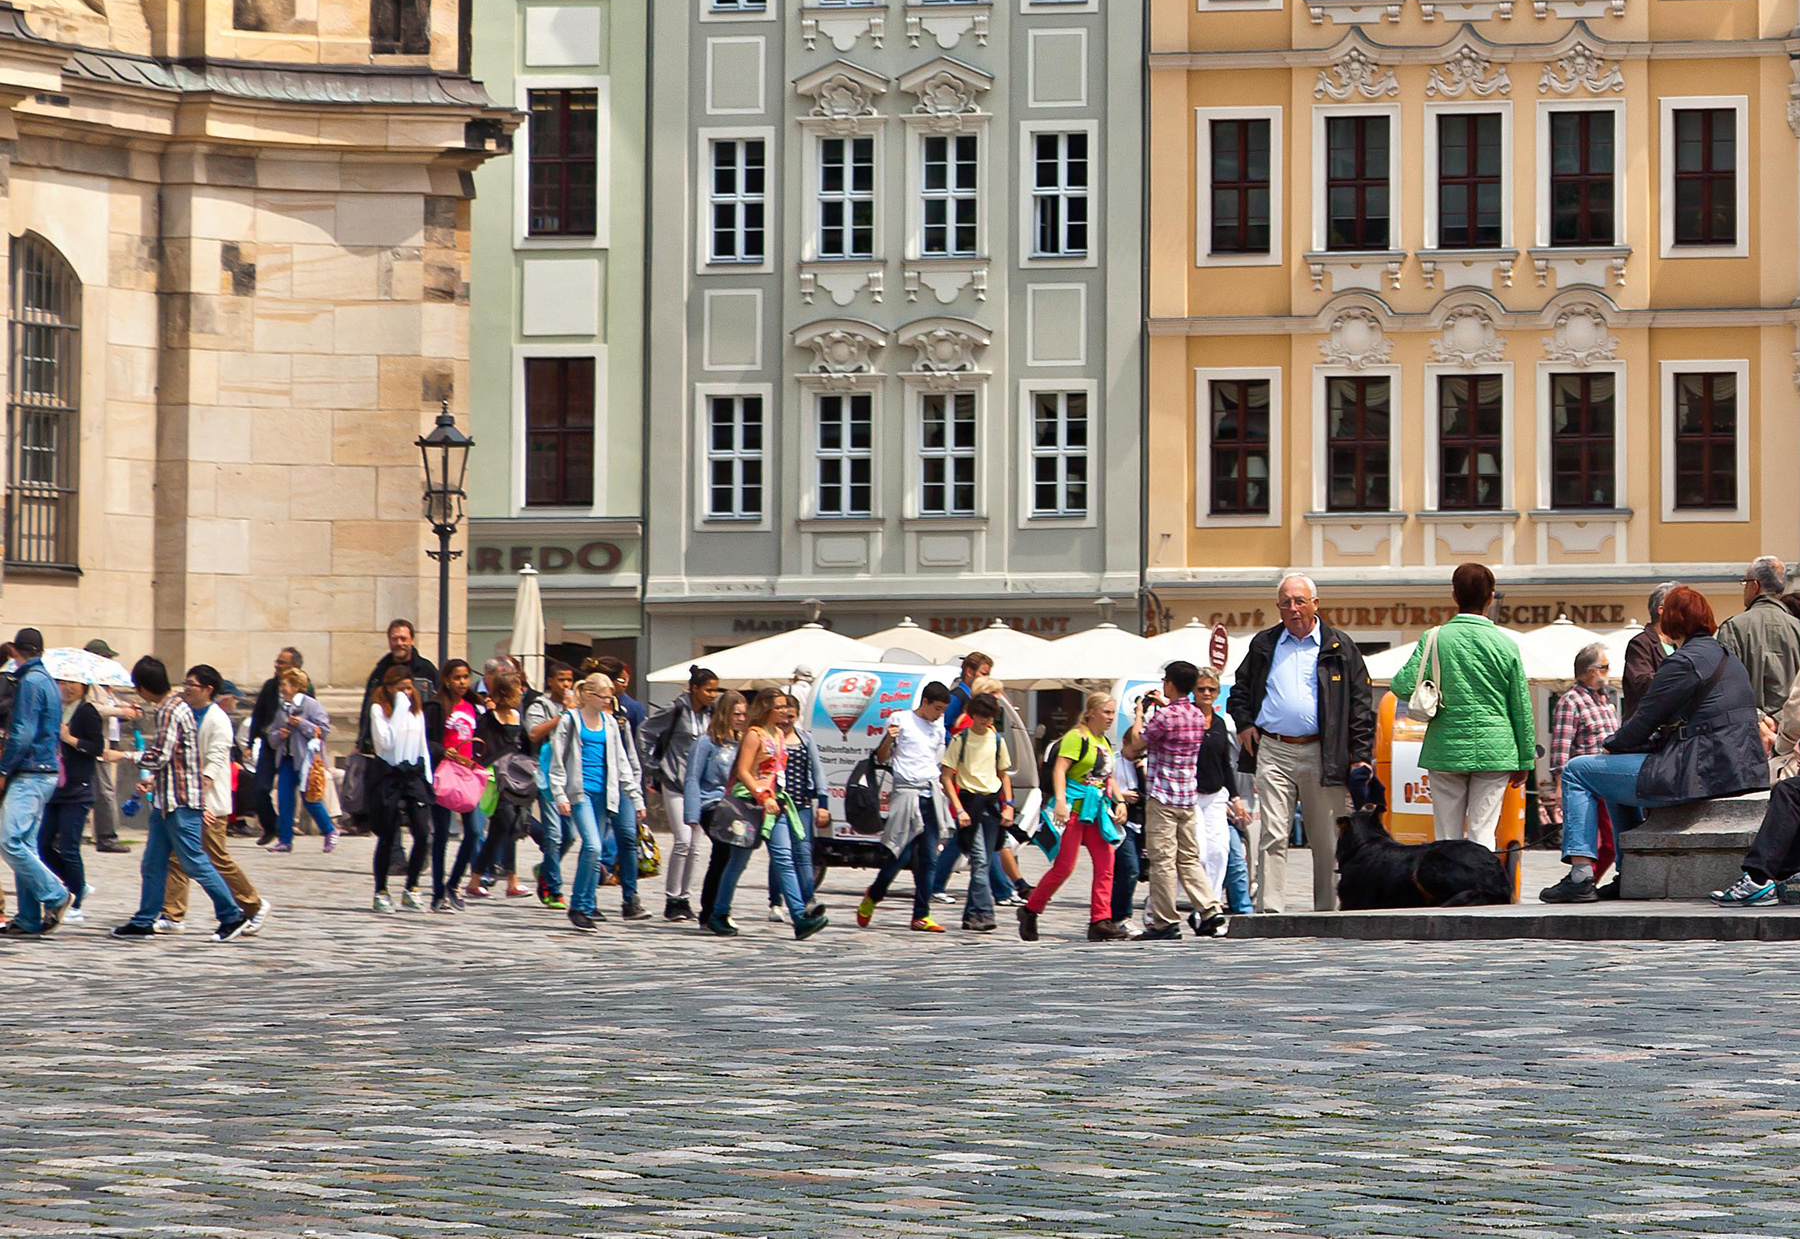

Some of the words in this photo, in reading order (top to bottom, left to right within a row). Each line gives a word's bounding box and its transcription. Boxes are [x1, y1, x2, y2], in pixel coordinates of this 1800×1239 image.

[468, 541, 623, 572] REDO
[930, 617, 1070, 631] RESTARANT
[1210, 609, 1265, 627] CAFÉ
